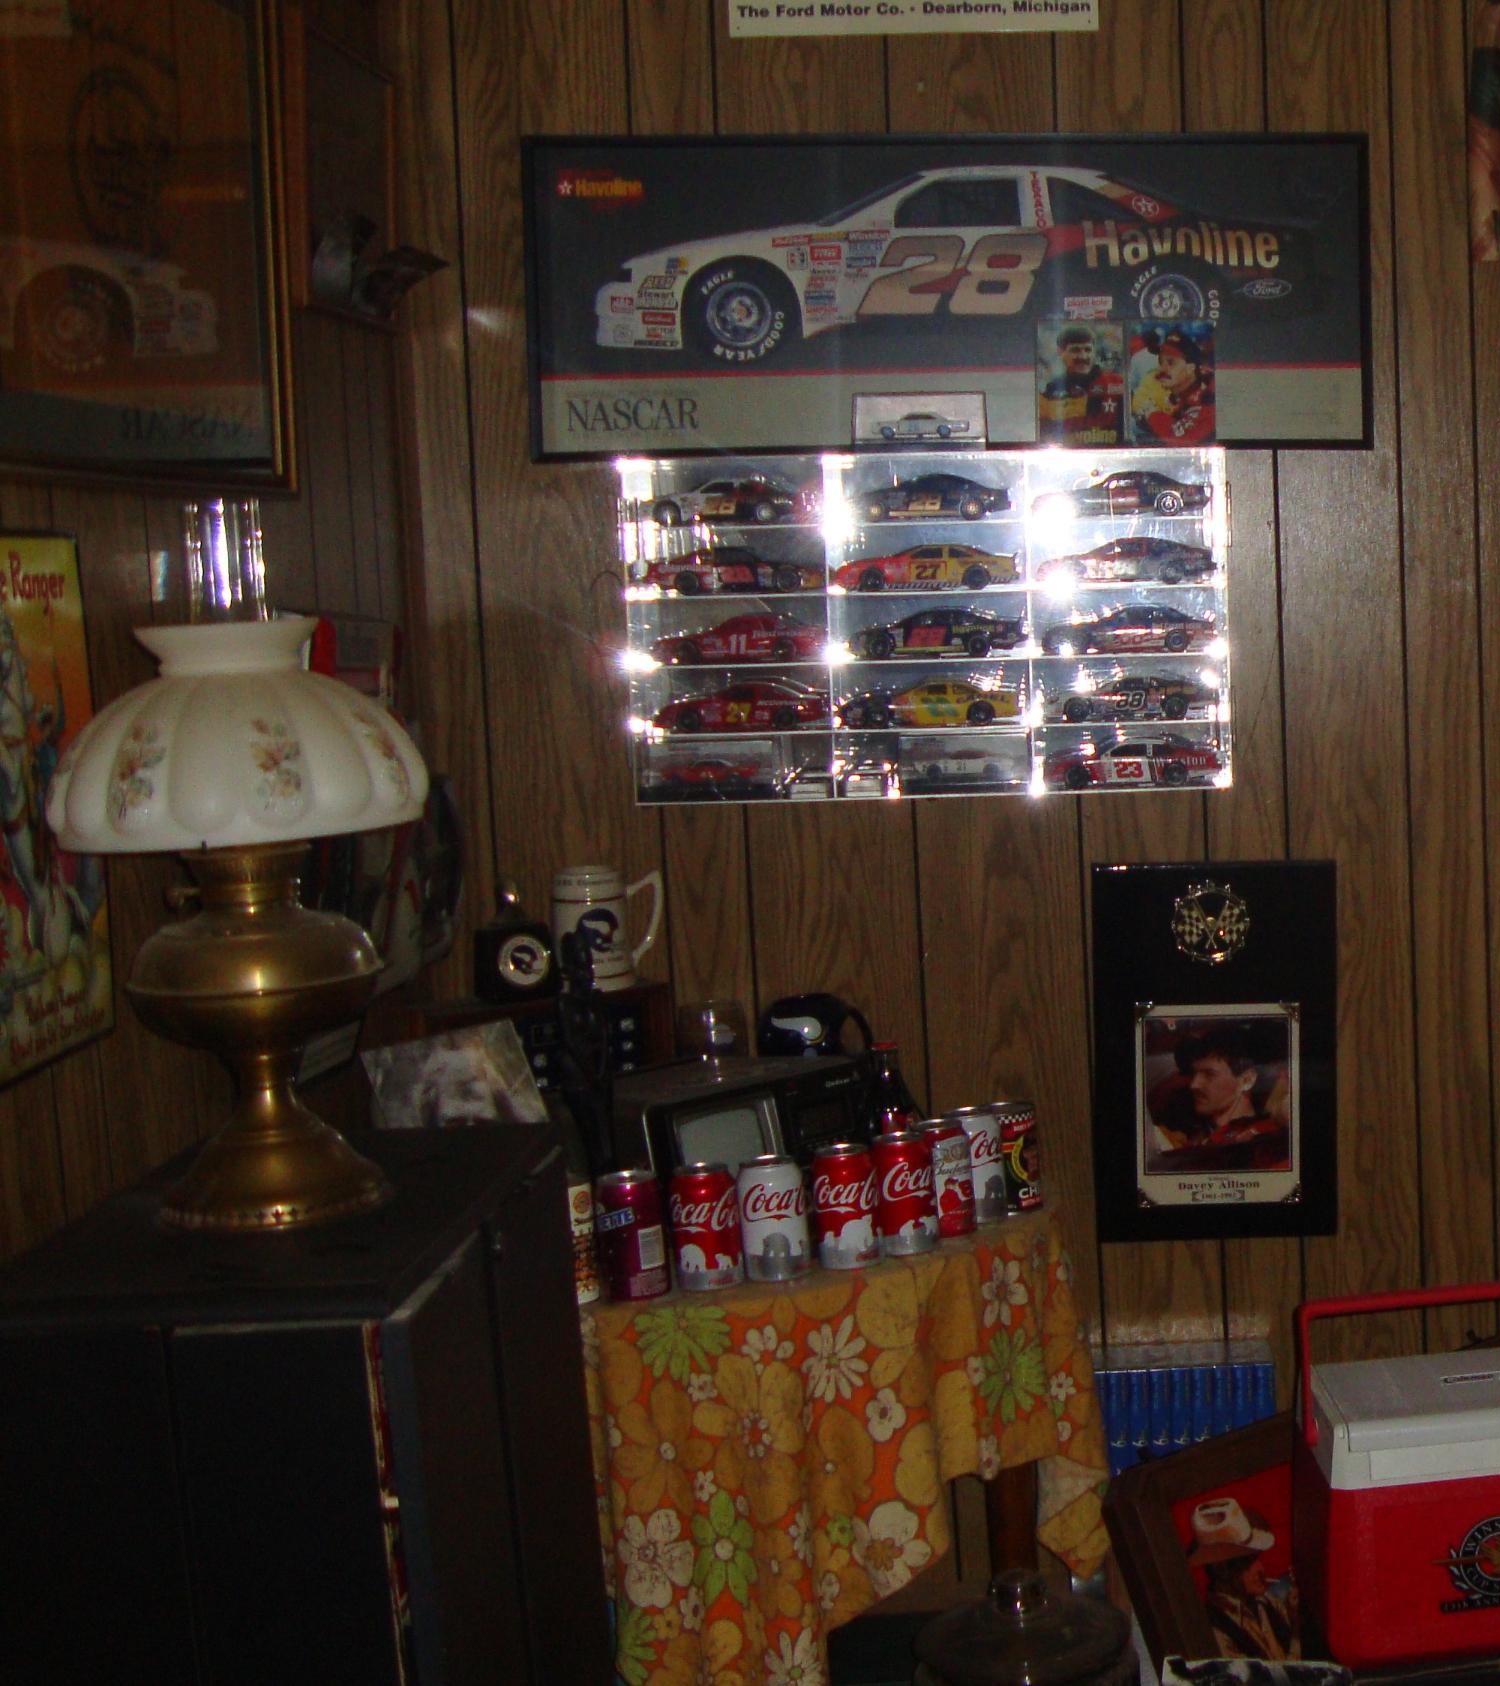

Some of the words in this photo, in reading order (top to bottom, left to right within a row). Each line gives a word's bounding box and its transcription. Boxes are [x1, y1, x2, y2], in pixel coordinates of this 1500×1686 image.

[738, 5, 769, 18] The
[776, 5, 815, 17] Ford
[820, 4, 870, 17] Motor
[876, 2, 905, 16] Co.
[922, 0, 1007, 15] Dearborn,
[1013, 0, 1092, 13] Michigan
[575, 179, 643, 197] Havoline
[1082, 218, 1280, 269] Havoline
[858, 233, 1049, 316] 28
[566, 397, 700, 432] NASCAR
[914, 565, 941, 580] 27
[728, 633, 748, 655] 11
[1113, 761, 1144, 778] 23
[1178, 1181, 1214, 1191] Davey
[1219, 1179, 1260, 1189] Allison
